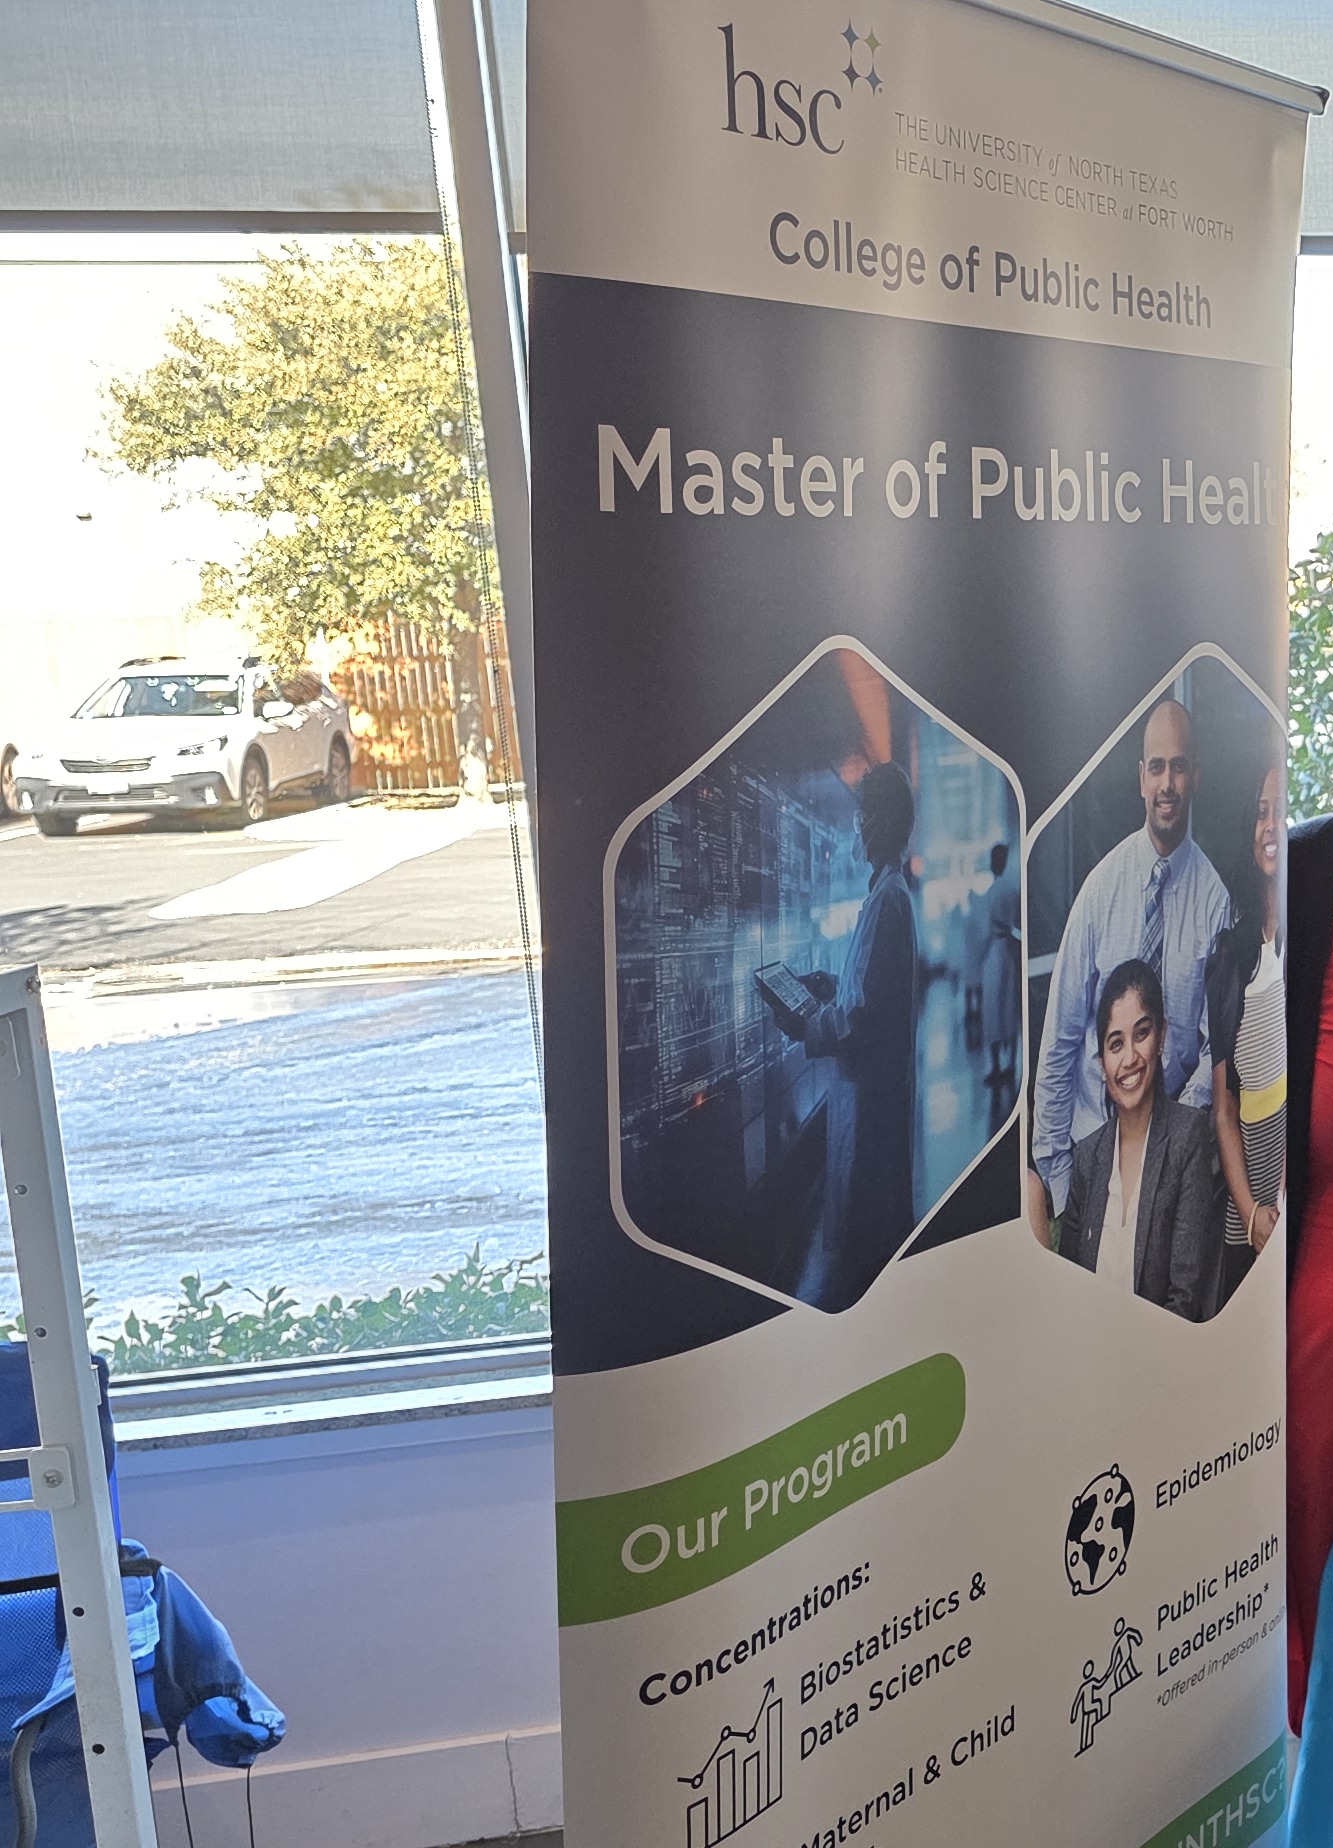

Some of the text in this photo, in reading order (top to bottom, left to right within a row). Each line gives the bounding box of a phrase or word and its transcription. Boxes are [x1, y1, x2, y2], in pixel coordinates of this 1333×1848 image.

[718, 22, 845, 155] hsc
[895, 111, 1178, 199] THE UNIVERSITY of NORTH TEXAS
[895, 149, 1234, 242] HEALTH SCIENCE CENTER at FORT WORTH
[769, 211, 1212, 329] College of Public Health
[597, 423, 1278, 526] Master of Public Healt
[620, 1410, 908, 1575] Our Program
[1155, 1417, 1282, 1510] Epidemiology
[639, 1561, 871, 1705] Concentrations:
[1157, 1533, 1280, 1632] Public Health
[800, 1571, 987, 1706] Biostatistics &
[1207, 1630, 1259, 1686] in-person
[1261, 1622, 1268, 1639] &
[800, 1634, 973, 1761] Data Science
[801, 1704, 1016, 1848] Maternal & Child
[1178, 1755, 1286, 1848] NTHSC?
